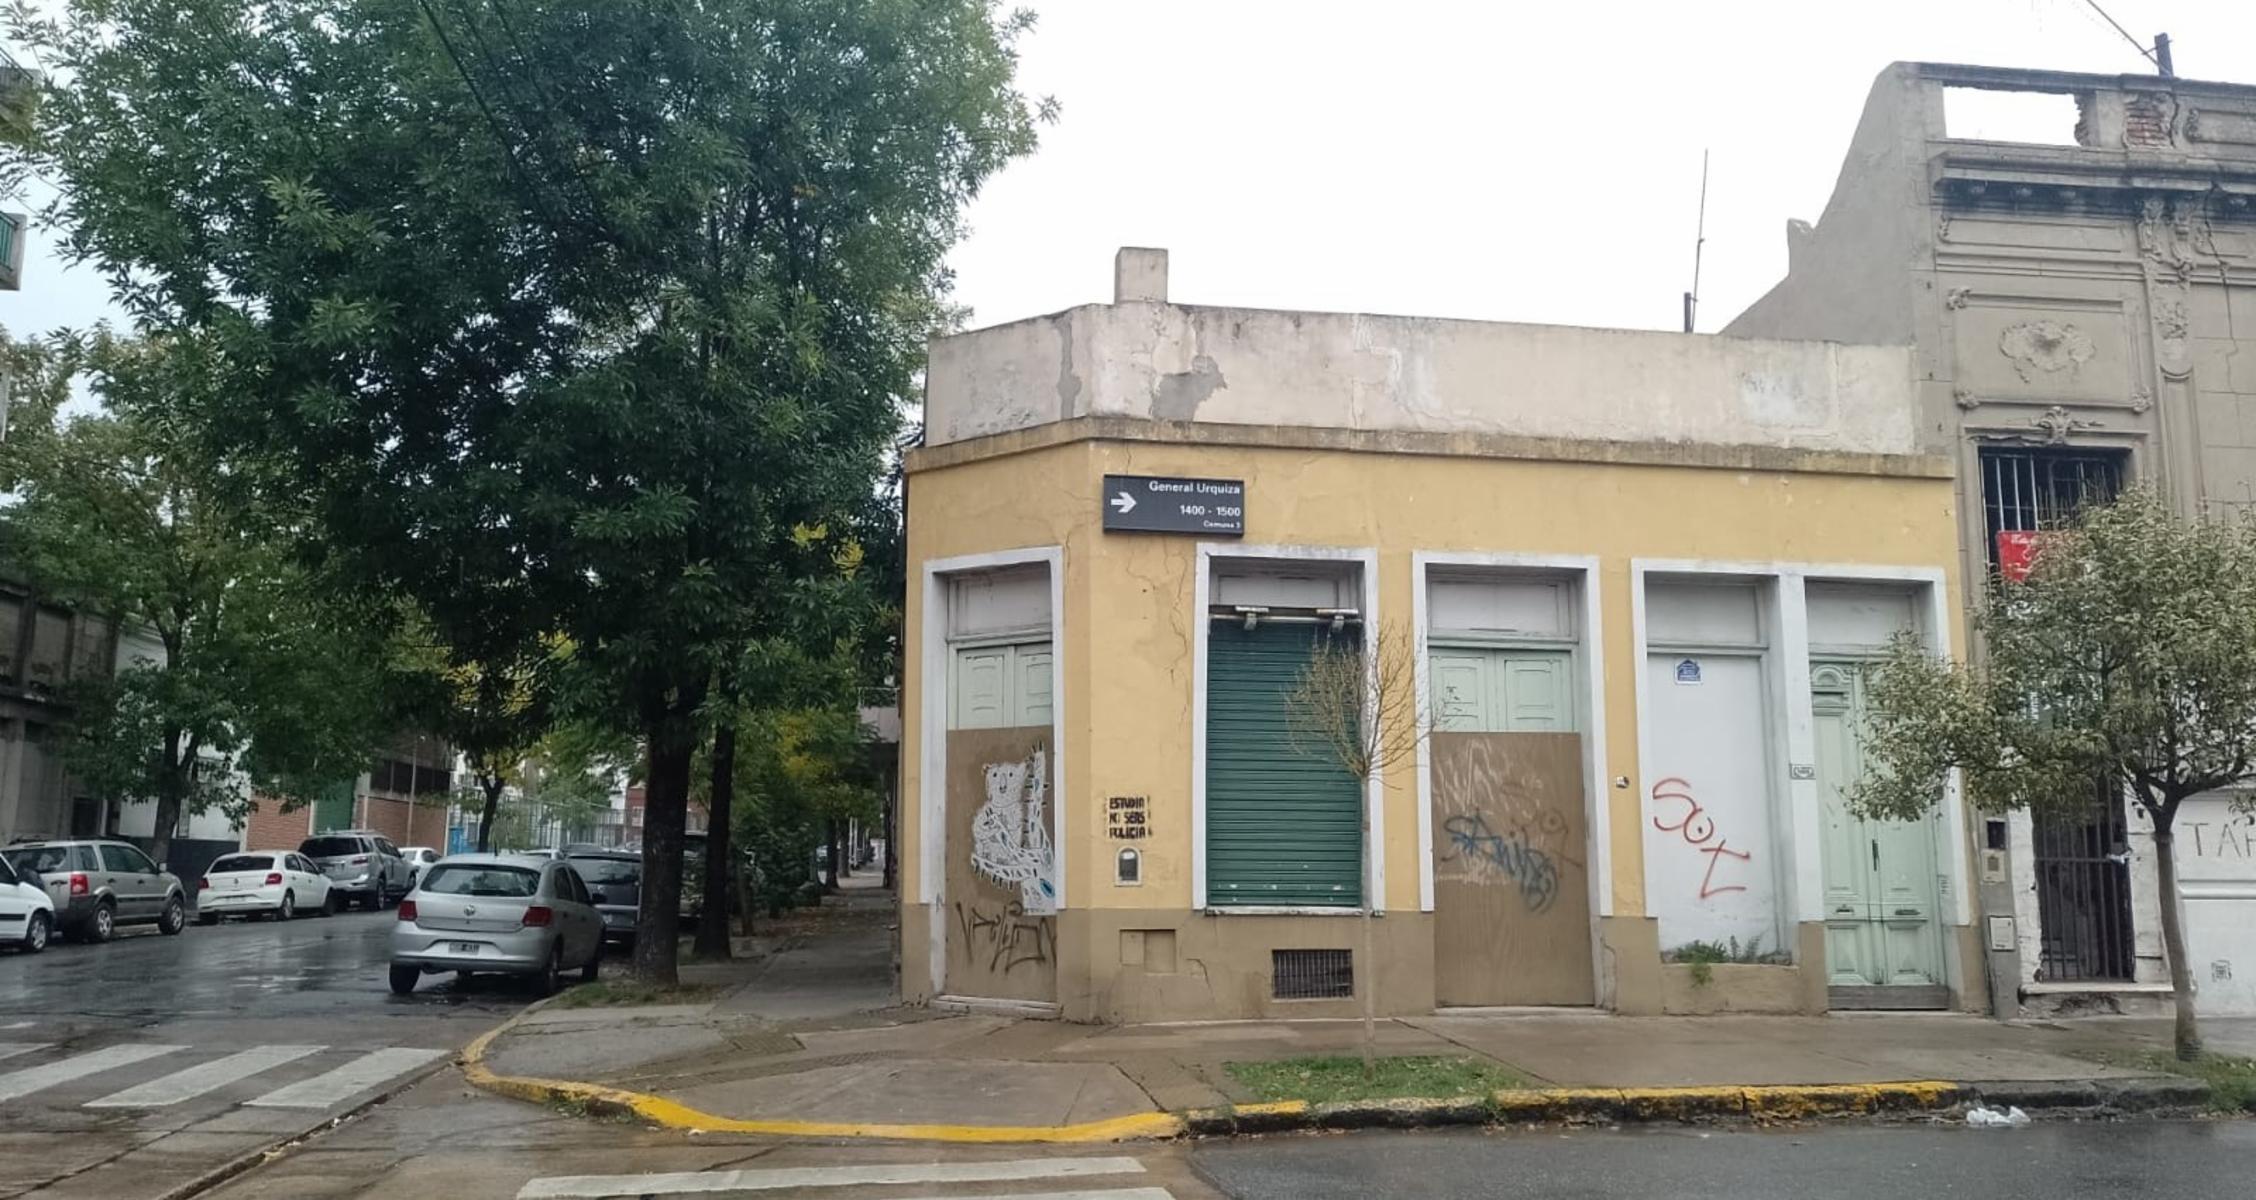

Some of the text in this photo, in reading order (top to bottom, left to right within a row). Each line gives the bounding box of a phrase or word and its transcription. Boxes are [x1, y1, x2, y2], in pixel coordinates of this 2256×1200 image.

[1148, 480, 1241, 496] General Urquiza
[1180, 504, 1205, 516] 1400
[1216, 506, 1241, 517] 1500
[1203, 519, 1234, 529] Comuna
